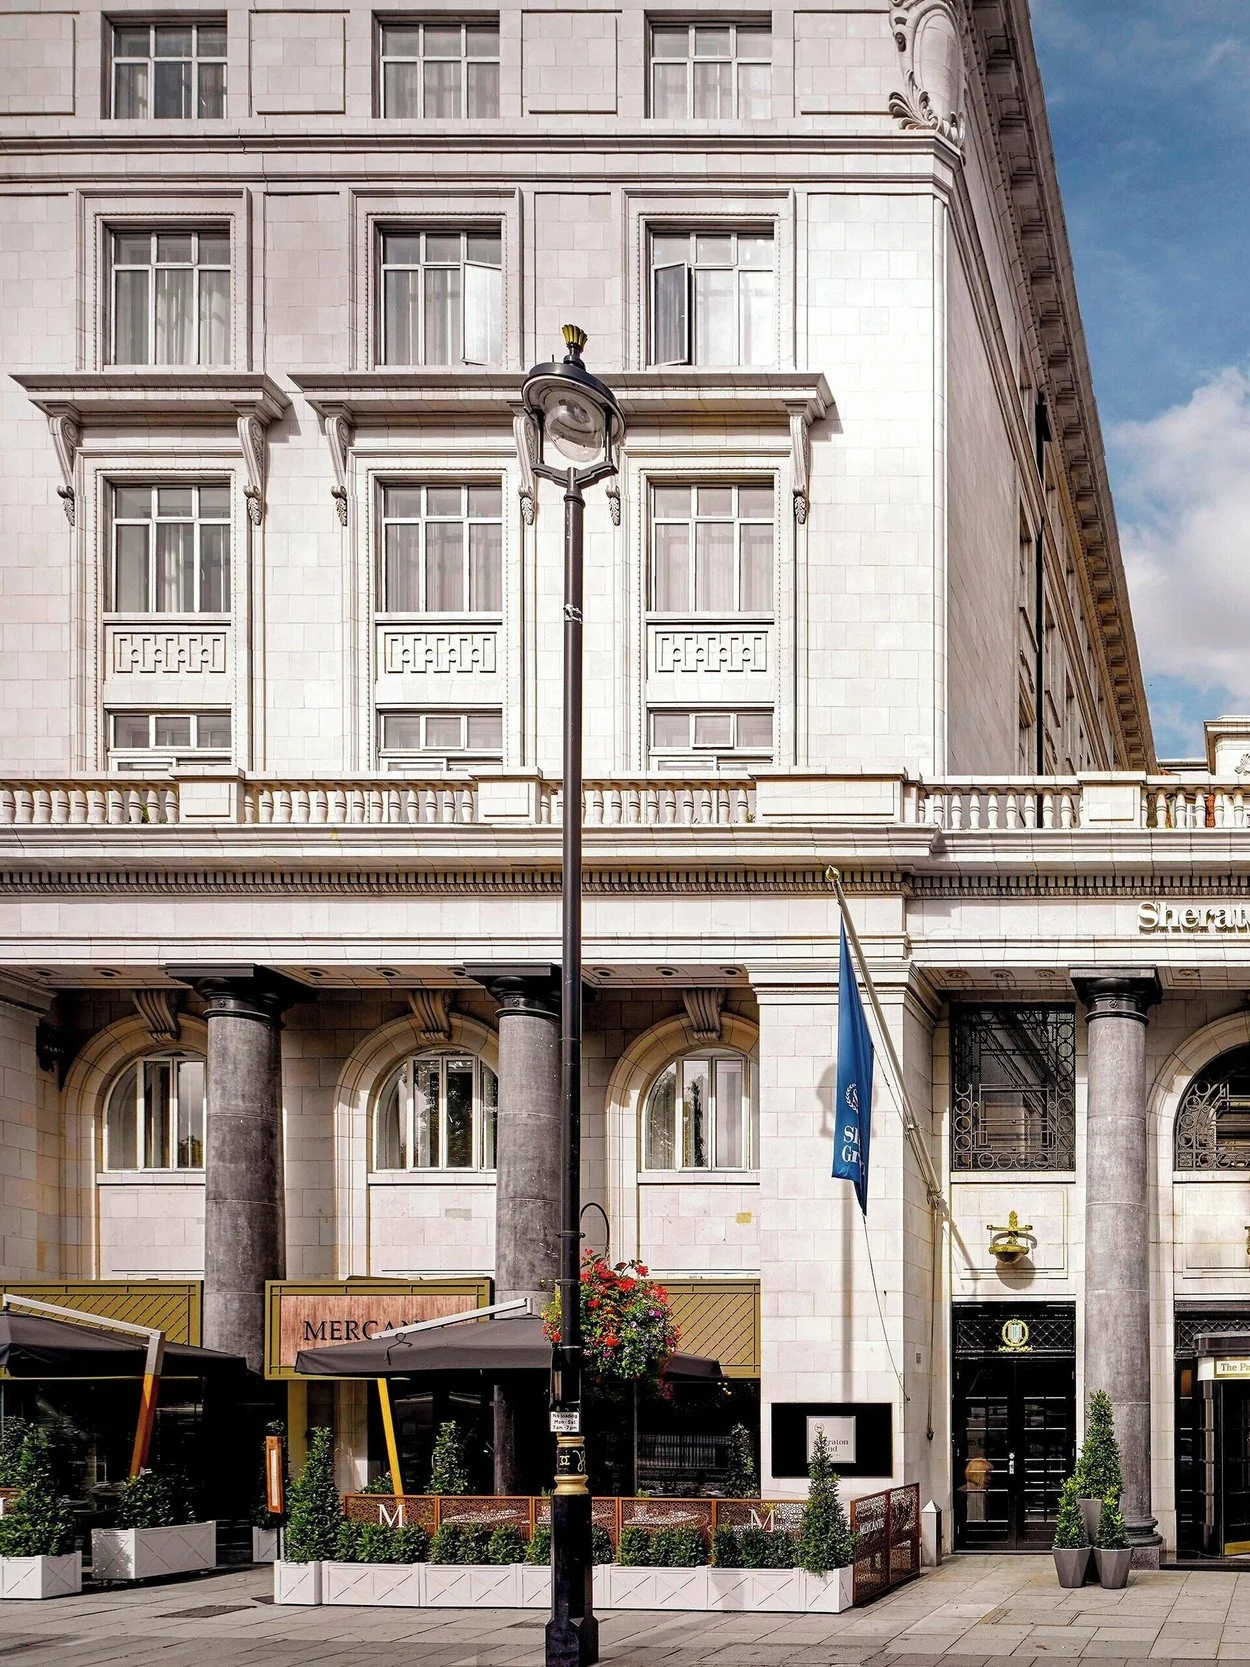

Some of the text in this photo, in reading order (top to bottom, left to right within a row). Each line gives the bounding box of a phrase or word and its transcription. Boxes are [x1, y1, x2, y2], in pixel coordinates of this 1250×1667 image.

[1221, 1363, 1237, 1372] The
[377, 1503, 406, 1529] M
[748, 1509, 778, 1533] M
